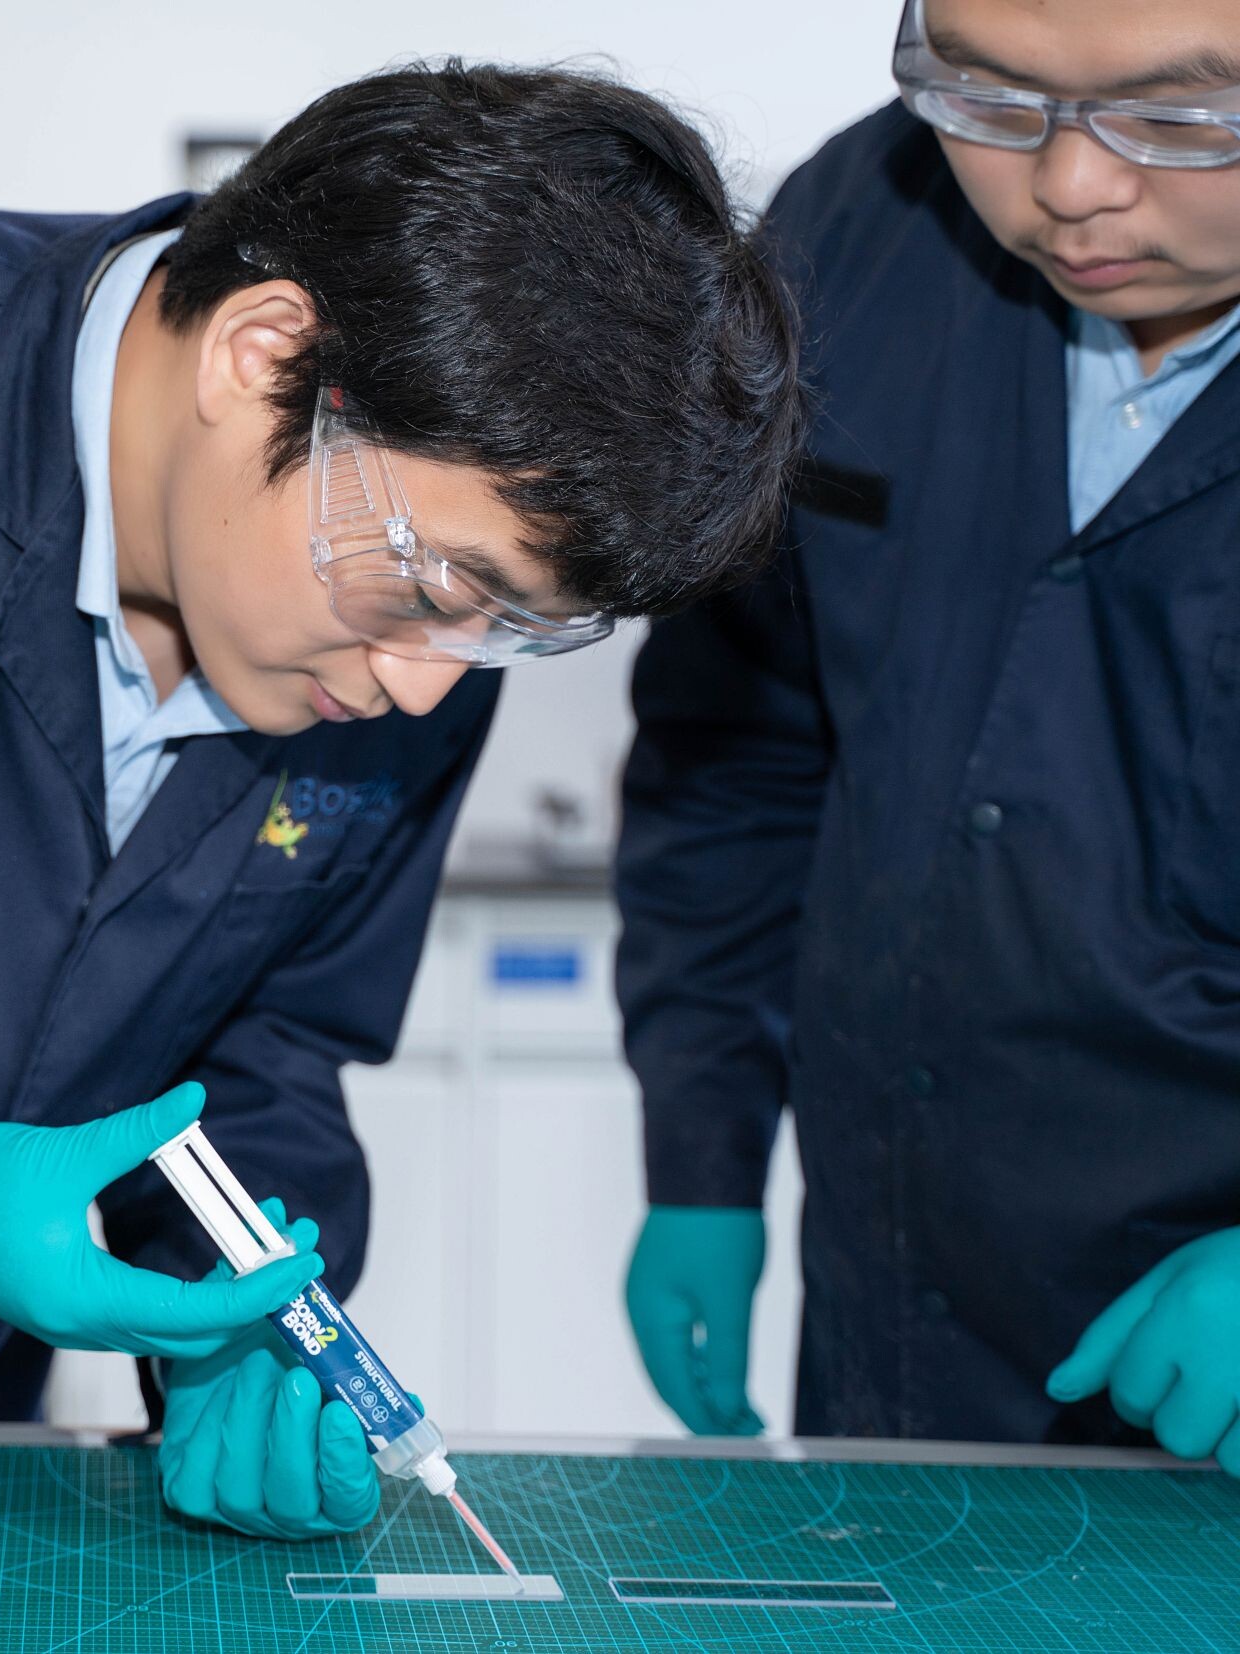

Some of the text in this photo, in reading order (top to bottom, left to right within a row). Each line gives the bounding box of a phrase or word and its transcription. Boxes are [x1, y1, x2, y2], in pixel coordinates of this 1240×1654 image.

[281, 1311, 322, 1356] BOND
[315, 1326, 338, 1349] 2
[334, 1382, 354, 1406] INSTANT
[354, 1350, 402, 1412] STRUCTURAL
